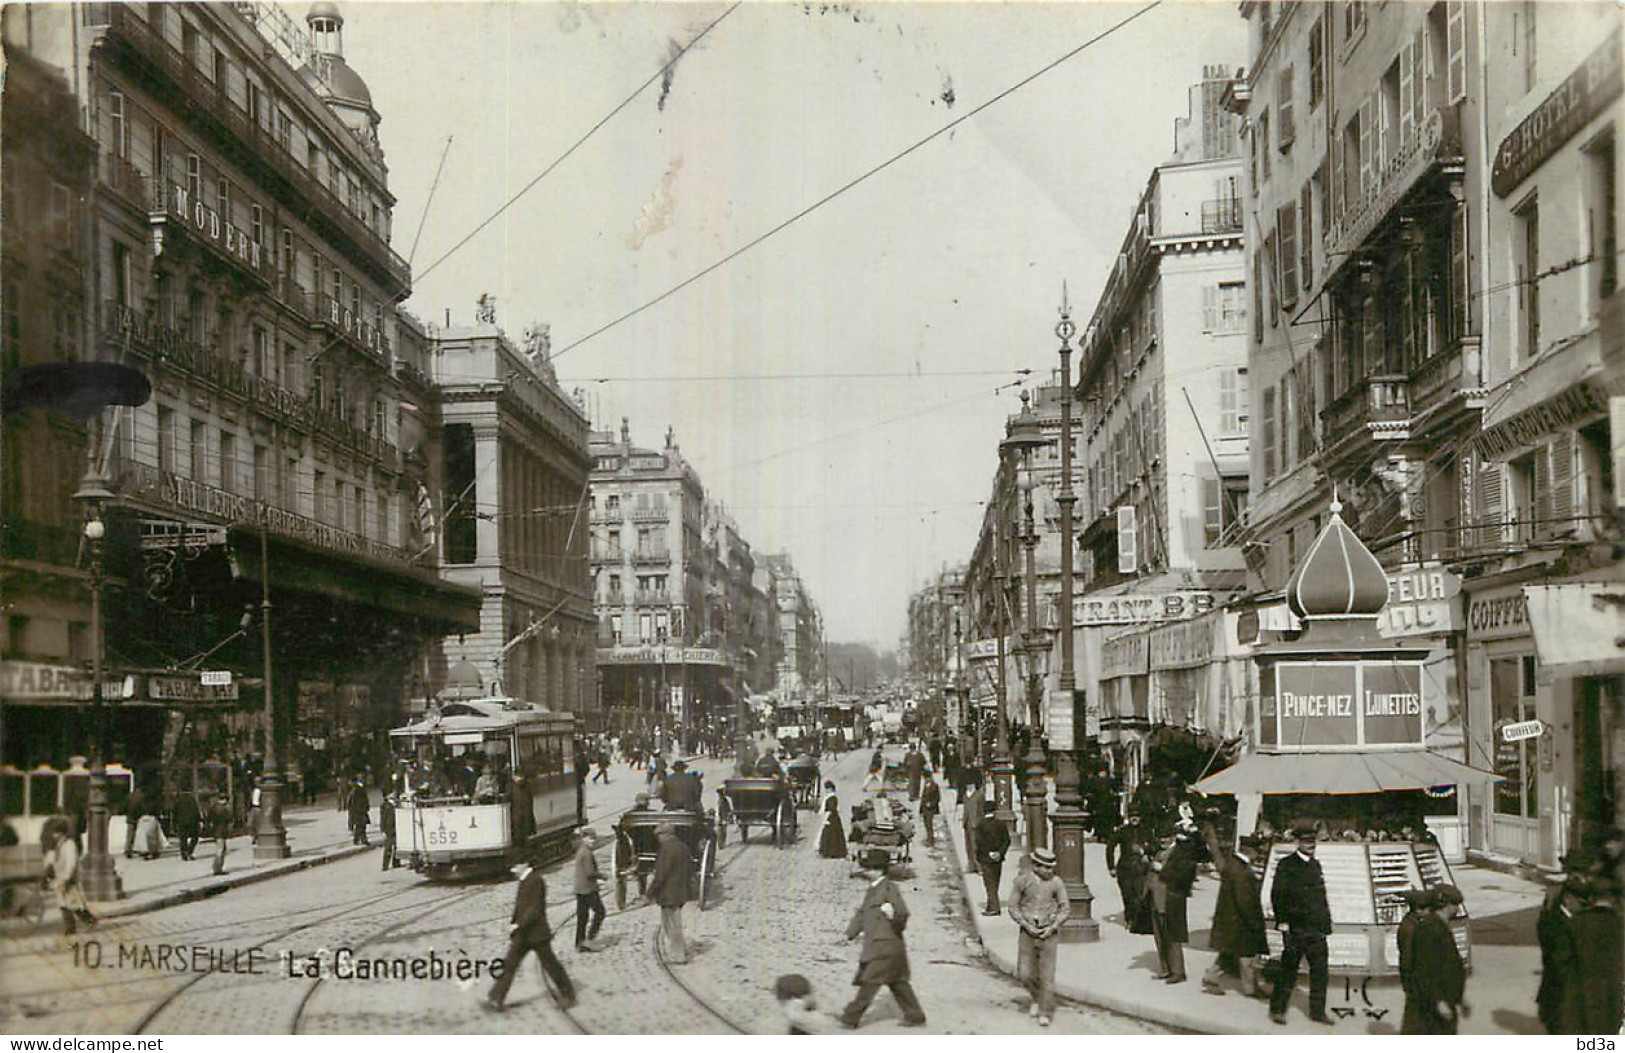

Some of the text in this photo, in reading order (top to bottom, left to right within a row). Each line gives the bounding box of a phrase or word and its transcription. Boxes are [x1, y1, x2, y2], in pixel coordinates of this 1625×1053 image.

[175, 185, 260, 270] MODERN
[331, 299, 384, 355] HOTEL
[1282, 692, 1352, 718] PINCE-NEZ
[1365, 690, 1420, 716] LUNETTES
